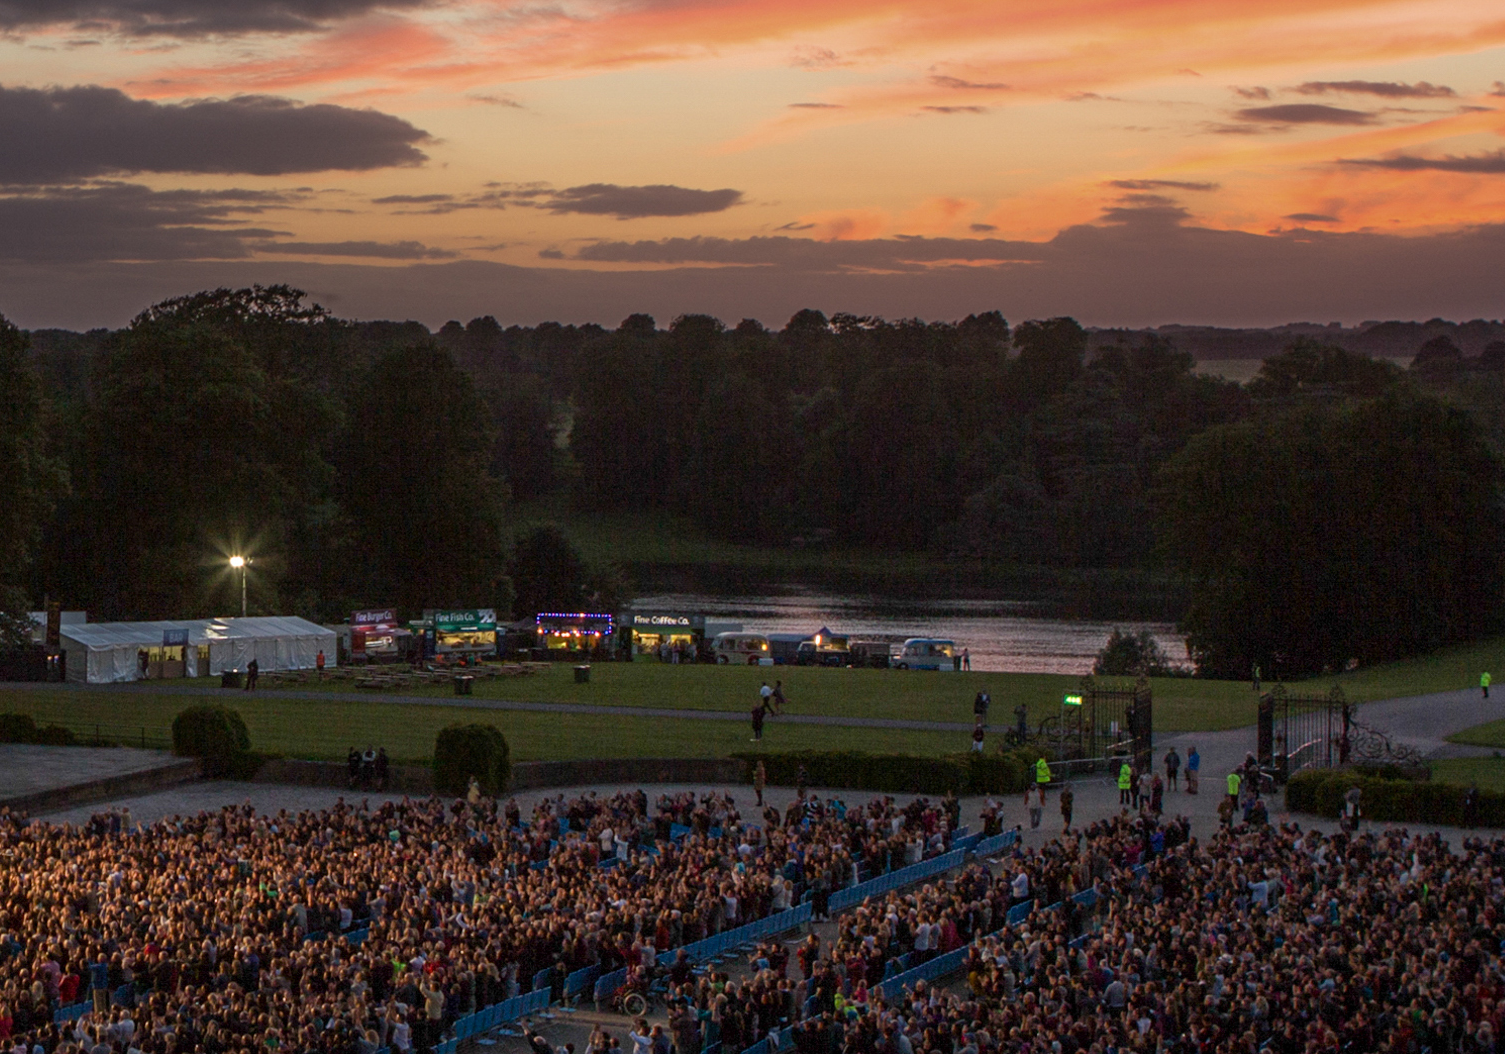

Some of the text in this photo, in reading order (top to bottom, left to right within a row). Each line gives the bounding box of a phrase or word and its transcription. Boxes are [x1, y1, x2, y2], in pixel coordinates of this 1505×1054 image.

[355, 612, 367, 622] Fine
[367, 612, 384, 623] Burger
[435, 612, 475, 622] Fine Fish Co.
[634, 615, 690, 625] Fine Coffee Co.
